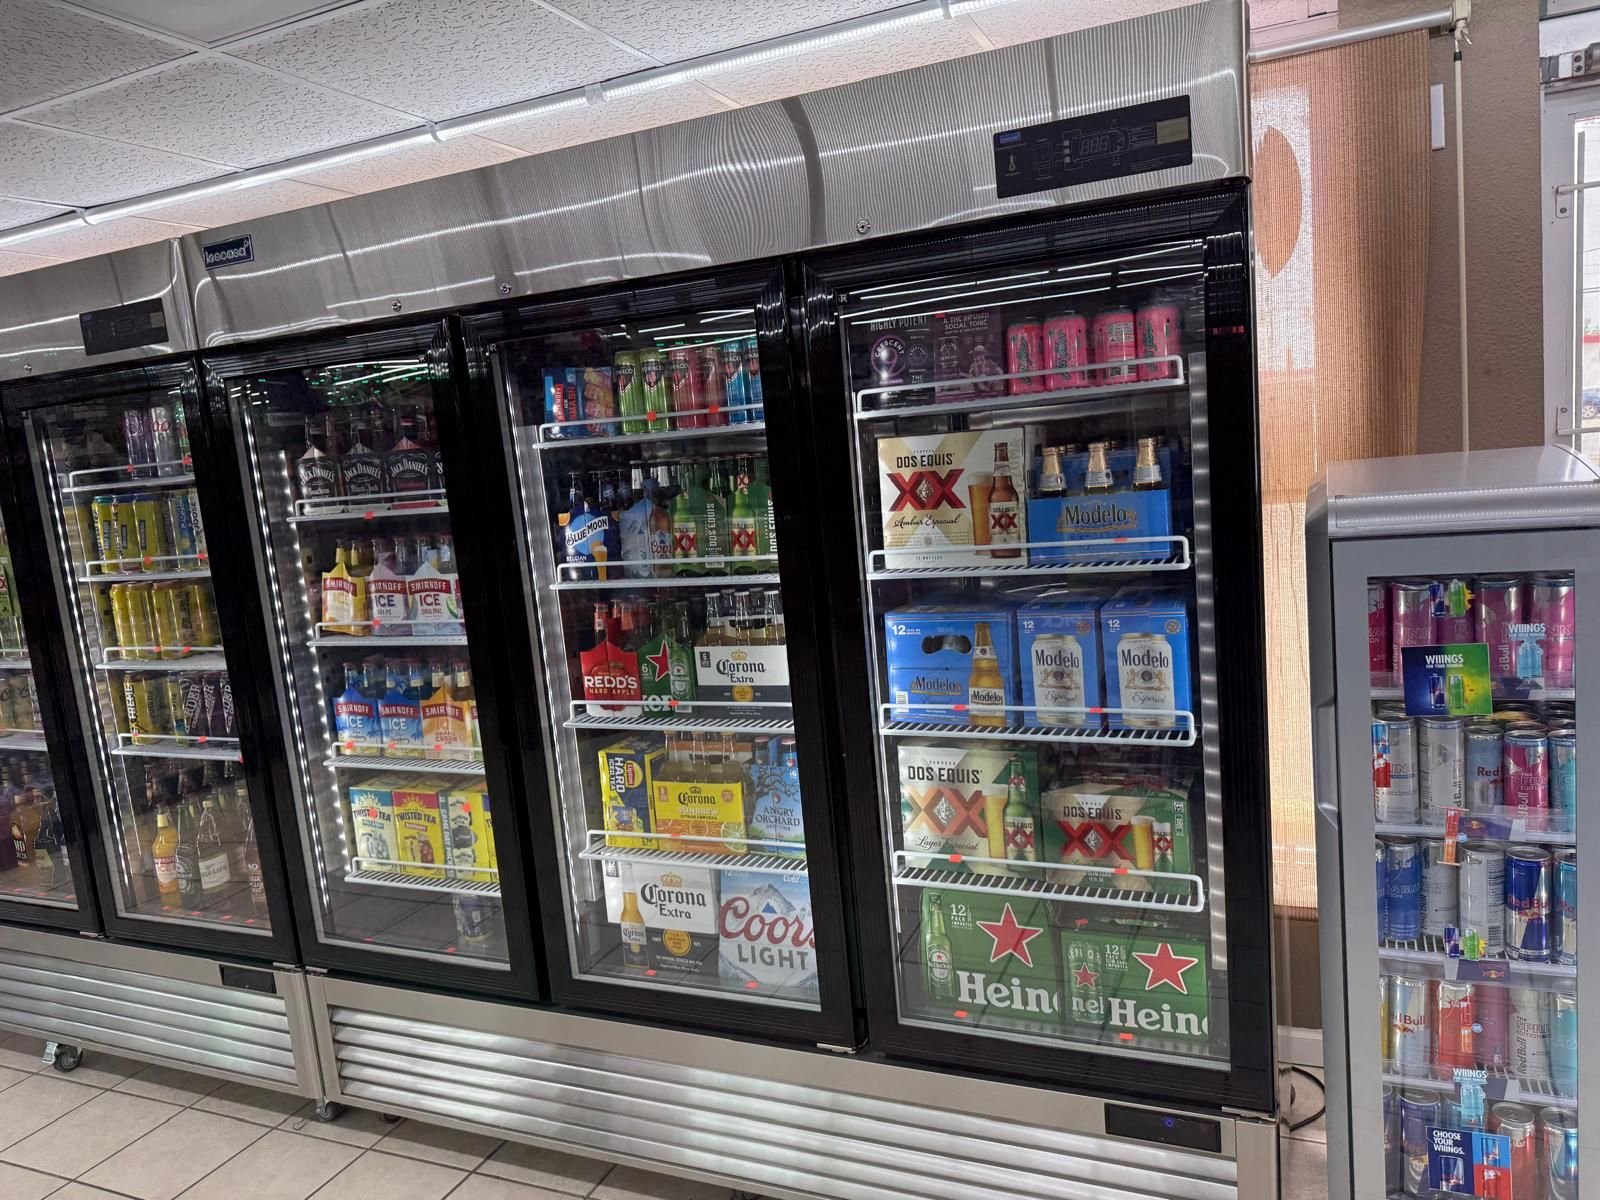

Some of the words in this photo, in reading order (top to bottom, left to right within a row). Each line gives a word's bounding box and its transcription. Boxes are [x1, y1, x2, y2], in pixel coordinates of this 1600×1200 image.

[875, 339, 905, 358] CRESCENT
[896, 456, 918, 468] DOS
[920, 453, 953, 467] EQUIS
[344, 468, 358, 481] JACK
[357, 463, 382, 480] DANIEL'S
[390, 463, 404, 478] JACK
[403, 458, 428, 475] DANIEL'S
[893, 516, 923, 529] Ambar
[925, 513, 962, 529] Especial
[1064, 504, 1127, 526] Modelo
[587, 517, 608, 535] MOON
[708, 530, 717, 547] DOS
[411, 581, 447, 592] SMIRNOFF
[375, 594, 396, 607] ICE
[419, 594, 441, 607] ICE
[892, 624, 906, 635] 12
[1023, 620, 1035, 629] 12
[1107, 619, 1120, 627] 12
[1508, 623, 1546, 633] WIIINGS
[1035, 649, 1080, 668] Modelo
[1121, 649, 1169, 668] Modelo
[1425, 654, 1464, 665] WIIINGS
[641, 663, 648, 673] 6
[716, 658, 766, 677] Corona
[584, 675, 638, 689] REDD'S
[730, 673, 754, 683] Extra
[916, 676, 956, 691] Modelo
[973, 690, 1002, 703] Modelo
[337, 704, 369, 714] SMIRNOFF
[380, 705, 415, 715] SMIRNOFF
[345, 716, 364, 728] ICE
[388, 718, 408, 730] ICE
[614, 757, 625, 793] HARD
[908, 766, 934, 781] DOS
[938, 767, 981, 784] EQUIS
[1476, 765, 1500, 776] Red
[678, 791, 716, 806] Corona
[353, 807, 380, 821] TWIST
[379, 811, 391, 823] TEA
[396, 811, 423, 821] TWISTED
[423, 813, 437, 825] TEA
[763, 807, 795, 817] ANGRY
[1063, 805, 1085, 818] DOS
[1088, 807, 1122, 820] EQUIS
[755, 814, 801, 826] ORCHARD
[640, 882, 707, 908] Corona
[660, 904, 692, 919] Extra
[950, 904, 967, 916] 12
[1105, 944, 1120, 955] 12
[737, 943, 808, 970] LIGHT
[1452, 1067, 1488, 1079] WIIINGS
[1432, 1129, 1462, 1141] CHOOSE
[1433, 1136, 1454, 1146] YOUR
[1433, 1143, 1465, 1155] WIIINGS.
